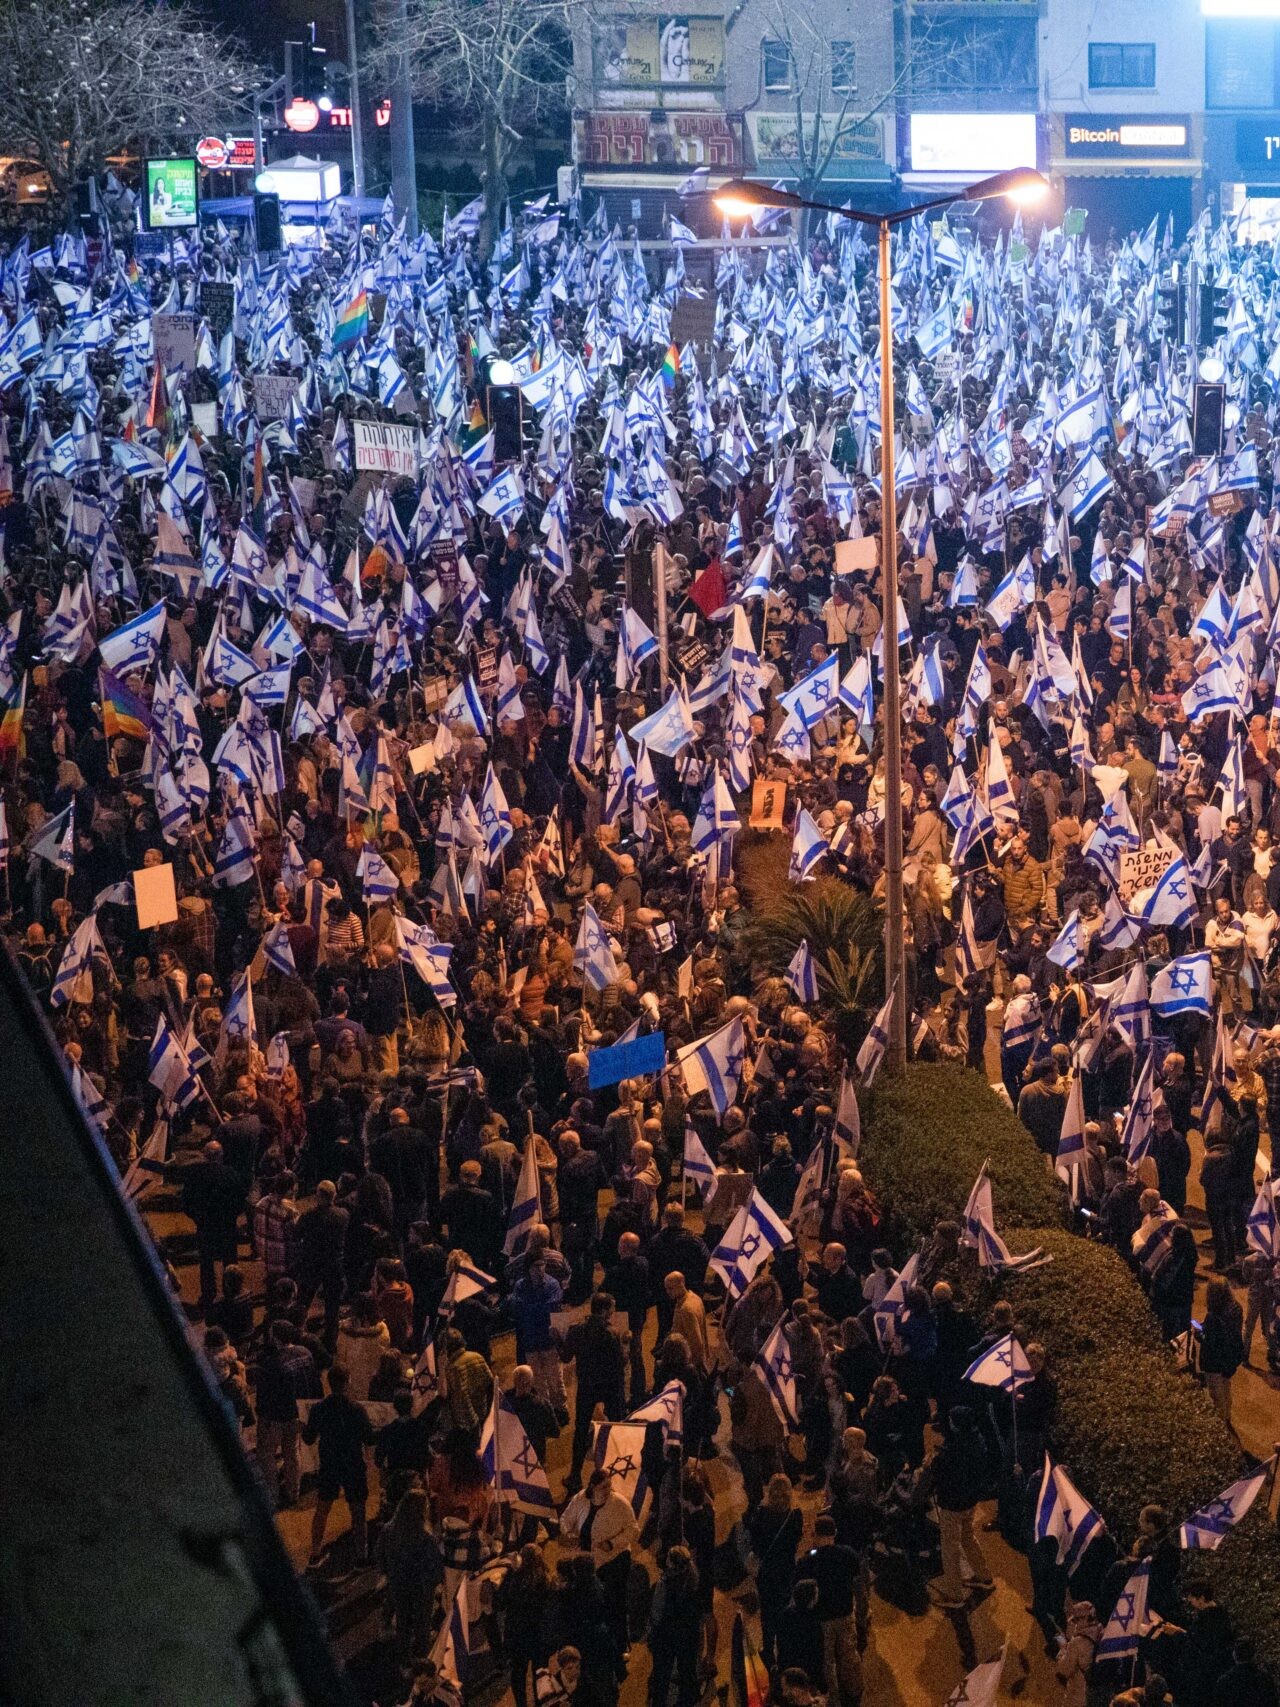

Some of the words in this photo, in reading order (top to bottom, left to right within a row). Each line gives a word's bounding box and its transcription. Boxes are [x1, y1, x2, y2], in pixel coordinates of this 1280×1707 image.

[641, 62, 652, 74] 21
[672, 55, 707, 67] Century
[704, 62, 715, 74] 21
[1070, 127, 1119, 143] Bitcoin
[395, 427, 411, 449] אין
[1125, 850, 1173, 867] ממשלת
[1133, 861, 1171, 876] השינוי
